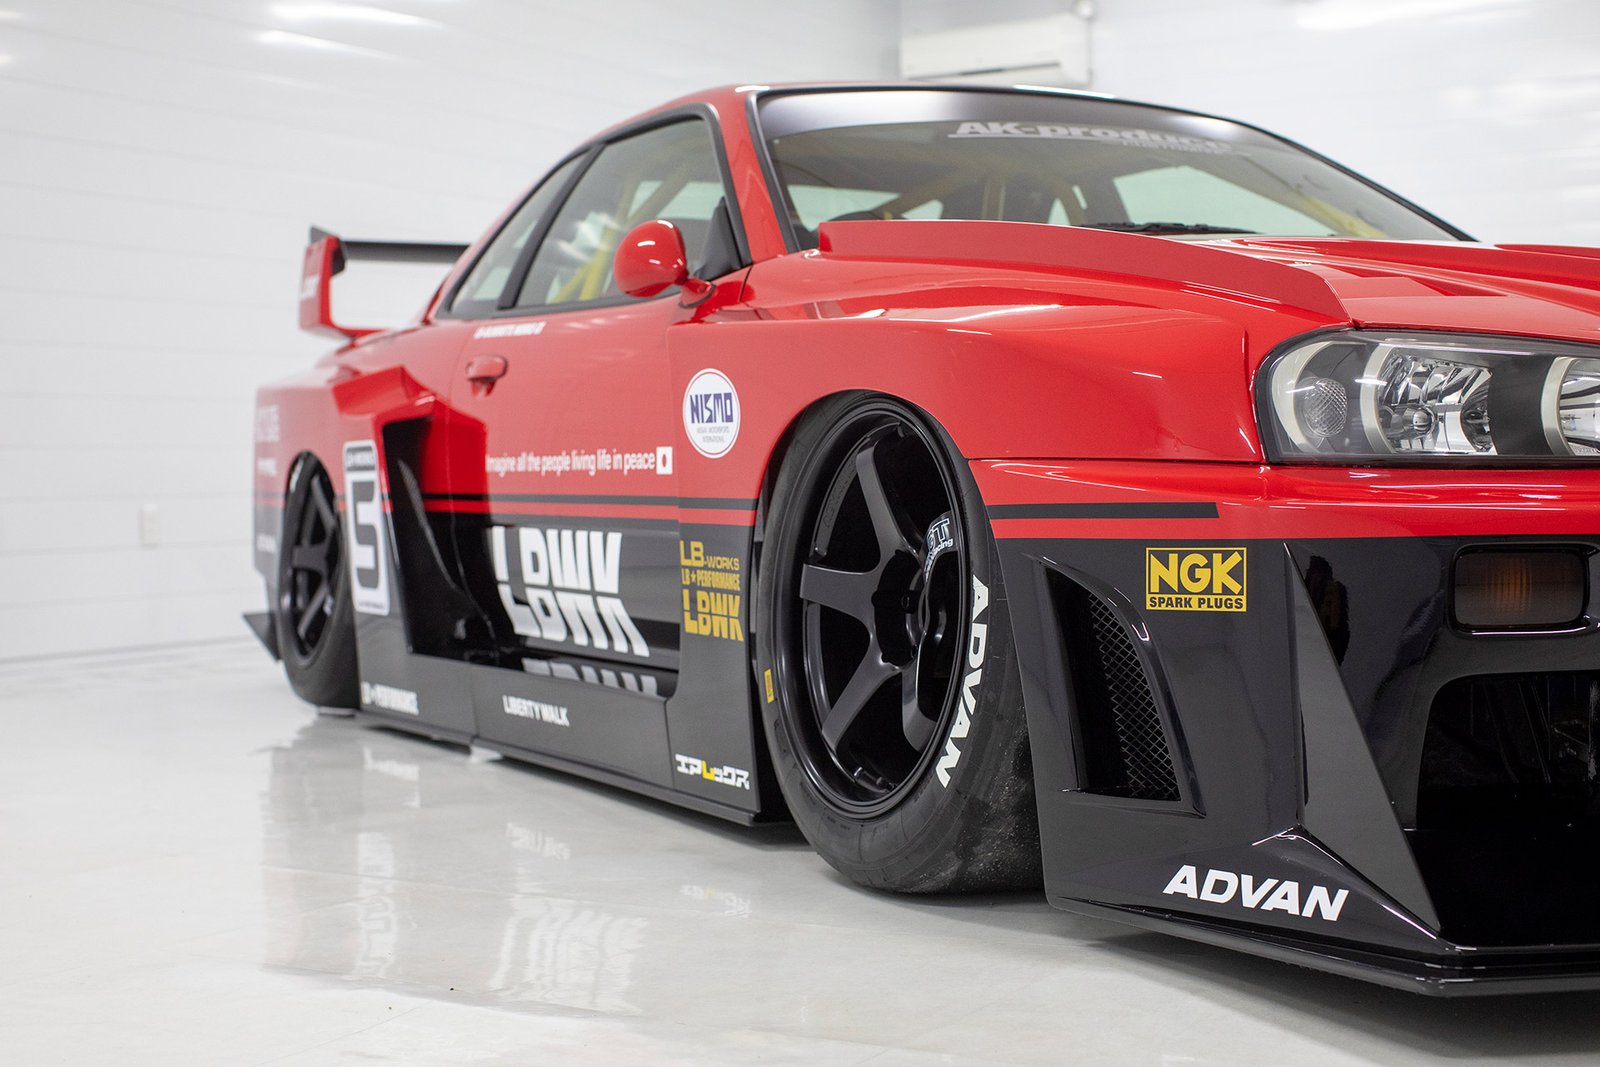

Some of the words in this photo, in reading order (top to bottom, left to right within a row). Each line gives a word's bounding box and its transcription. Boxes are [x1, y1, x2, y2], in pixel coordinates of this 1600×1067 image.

[690, 392, 733, 424] NISMO
[516, 451, 527, 473] all
[527, 451, 541, 473] the
[541, 450, 570, 477] people
[571, 449, 596, 477] living
[596, 448, 612, 471] life
[612, 448, 623, 471] in
[623, 452, 656, 476] peace
[352, 480, 380, 589] 5
[1150, 551, 1243, 595] NGK
[682, 588, 745, 643] LBWK
[1149, 596, 1193, 609] SPARK
[1197, 597, 1244, 609] PLUGS
[936, 574, 989, 789] ADVAN
[1162, 864, 1350, 922] ADVAN
